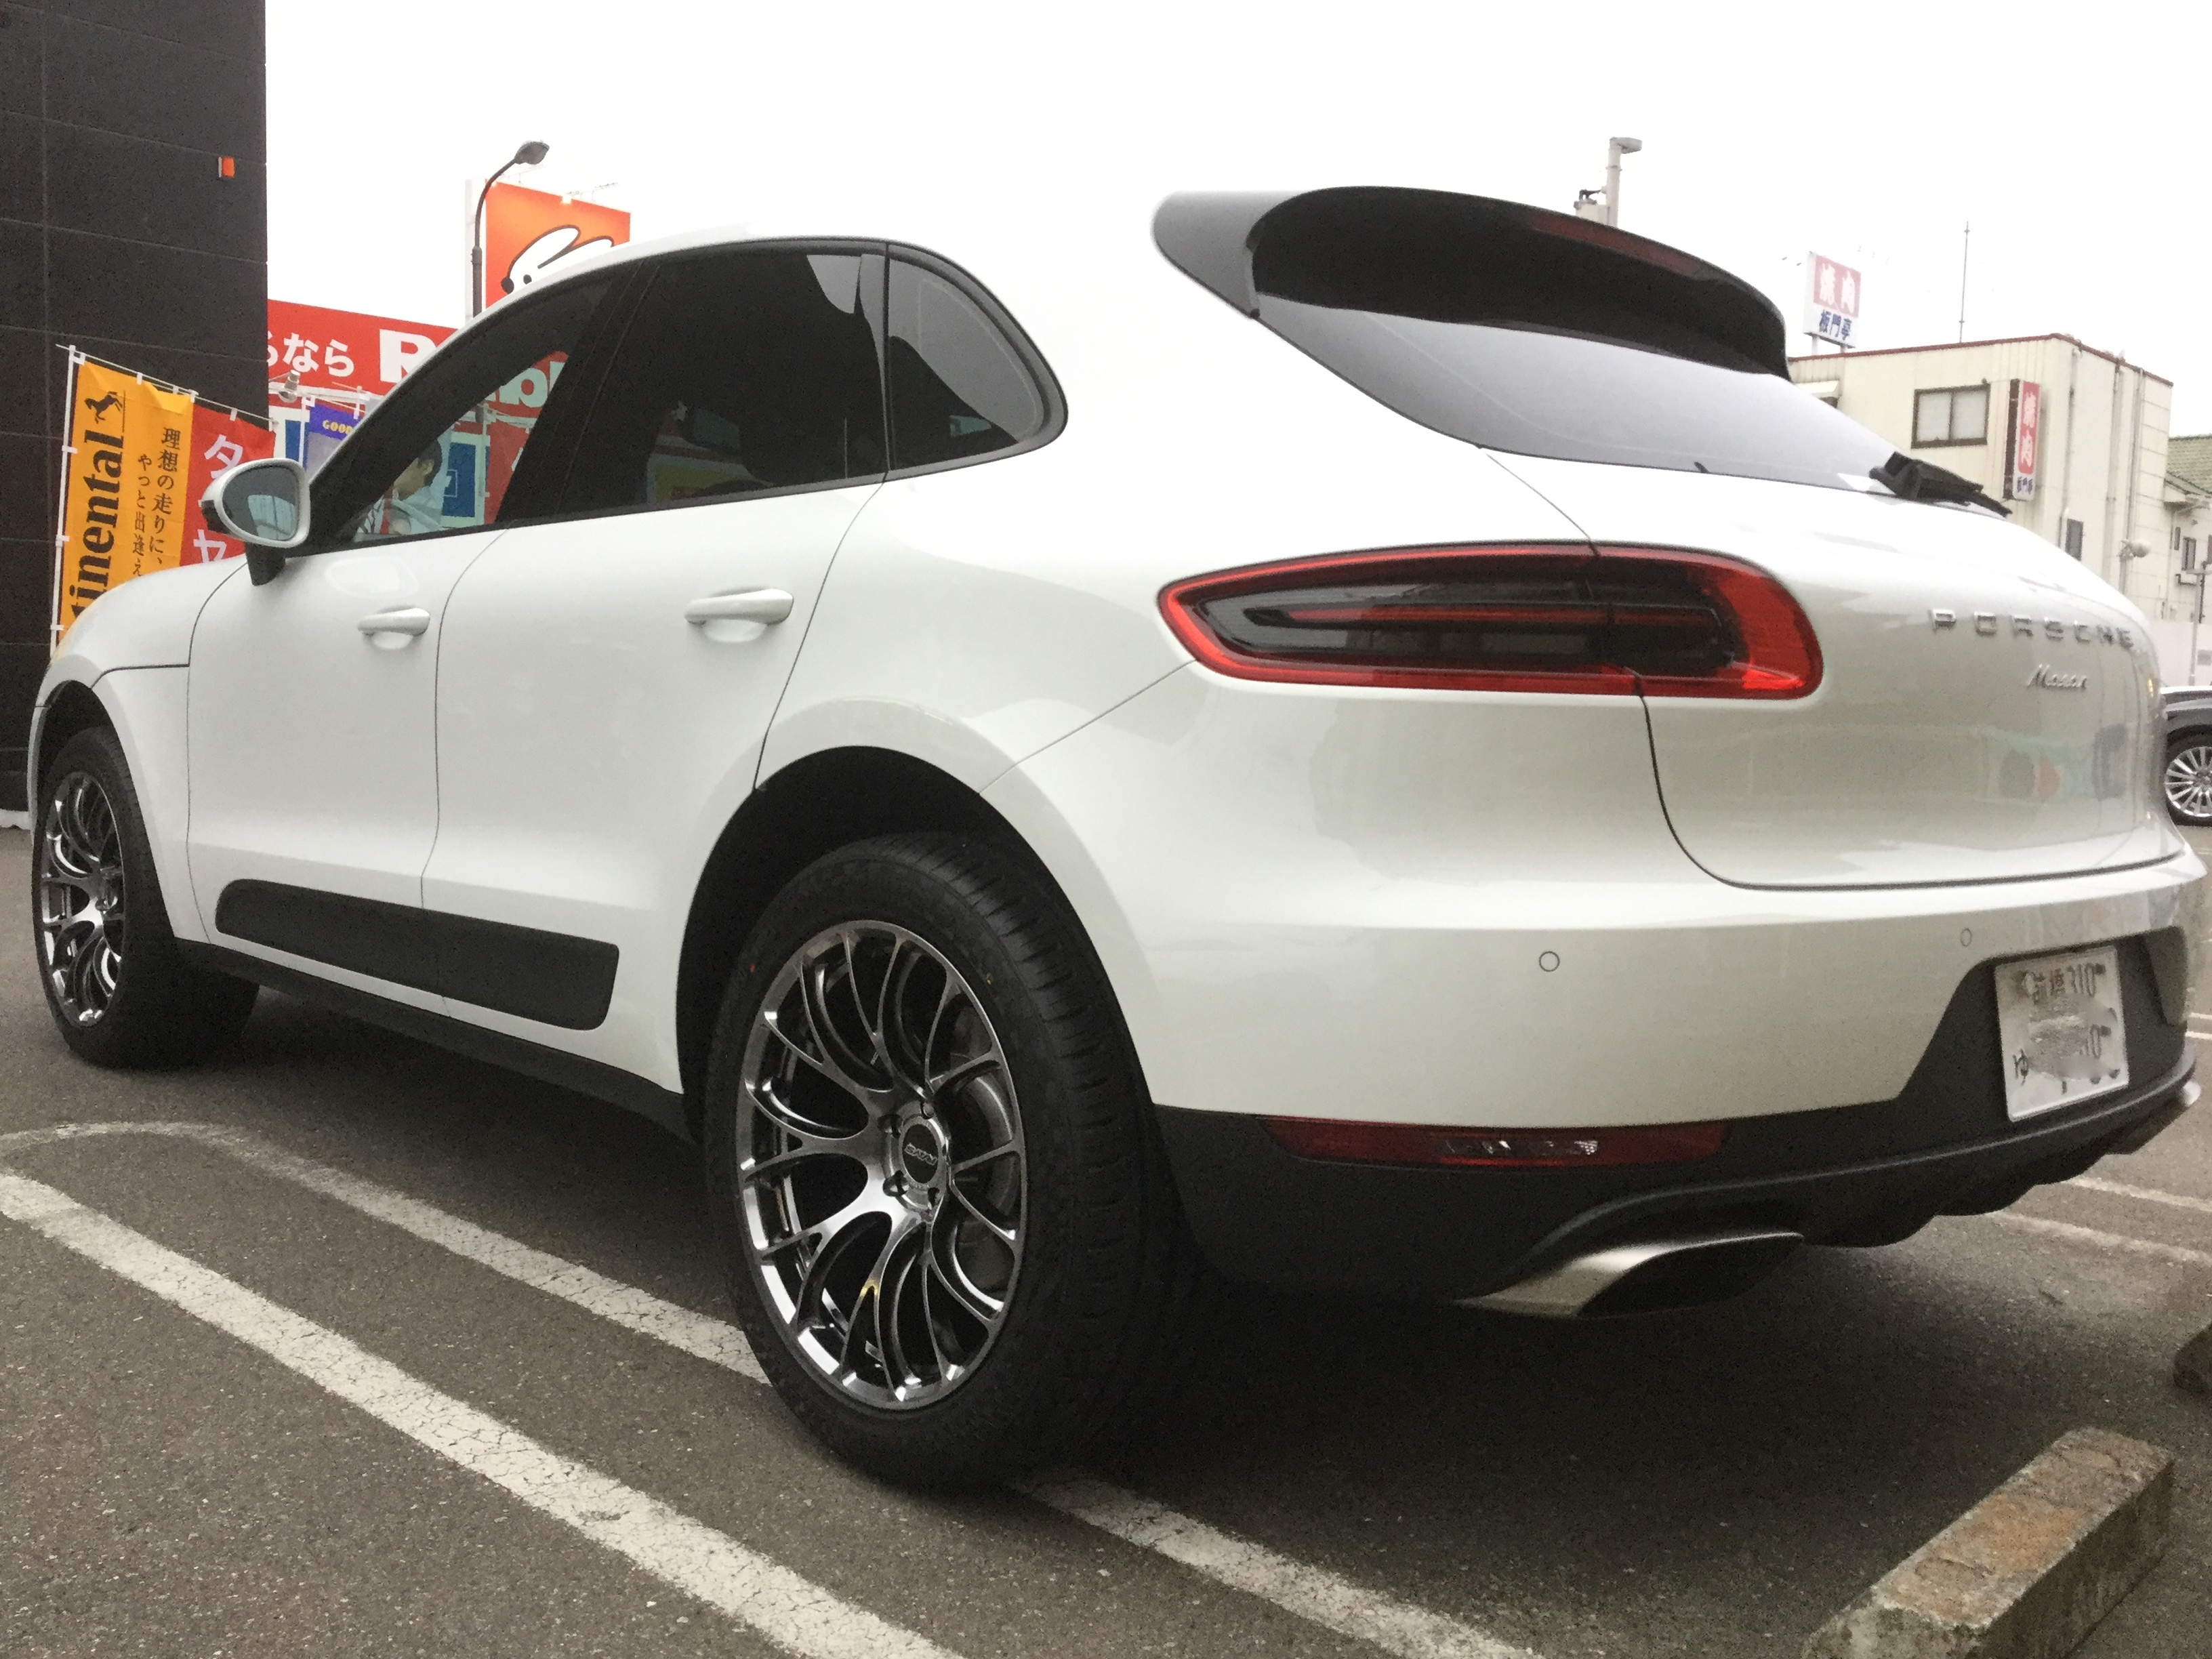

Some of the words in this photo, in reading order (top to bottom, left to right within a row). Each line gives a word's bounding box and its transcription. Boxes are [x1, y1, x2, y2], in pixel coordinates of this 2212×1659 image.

[149, 427, 181, 565] 理想の走りに、
[194, 434, 243, 563] タヤ
[1931, 609, 2134, 649] PORSCHE
[2027, 663, 2088, 691] Macan
